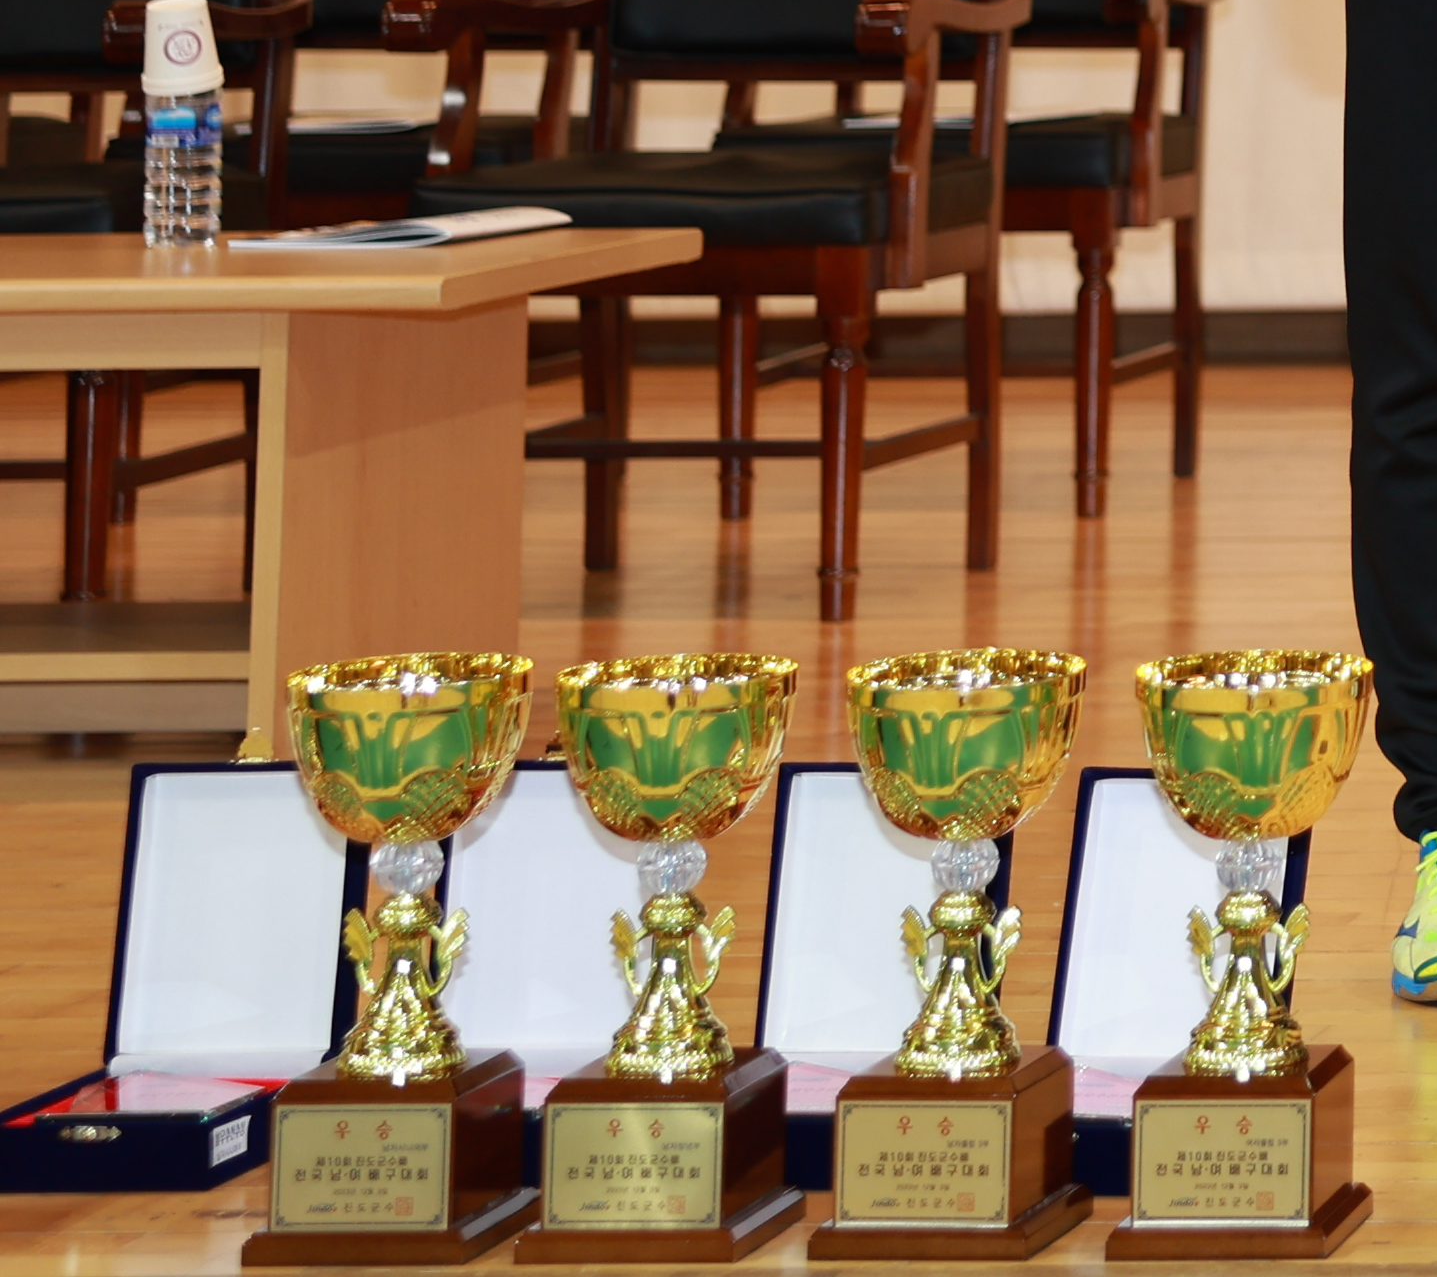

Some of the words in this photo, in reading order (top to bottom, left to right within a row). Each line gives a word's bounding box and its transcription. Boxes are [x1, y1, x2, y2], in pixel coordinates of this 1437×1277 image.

[316, 1156, 351, 1167] 제10회
[355, 1156, 408, 1167] 진도군수배
[588, 1154, 625, 1165] 제10회
[627, 1154, 680, 1165] 진도군수배
[879, 1151, 914, 1163] 제10회
[917, 1151, 969, 1163] 진도군수배
[1176, 1151, 1213, 1162] 제10회
[1216, 1151, 1268, 1162] 진도군수배
